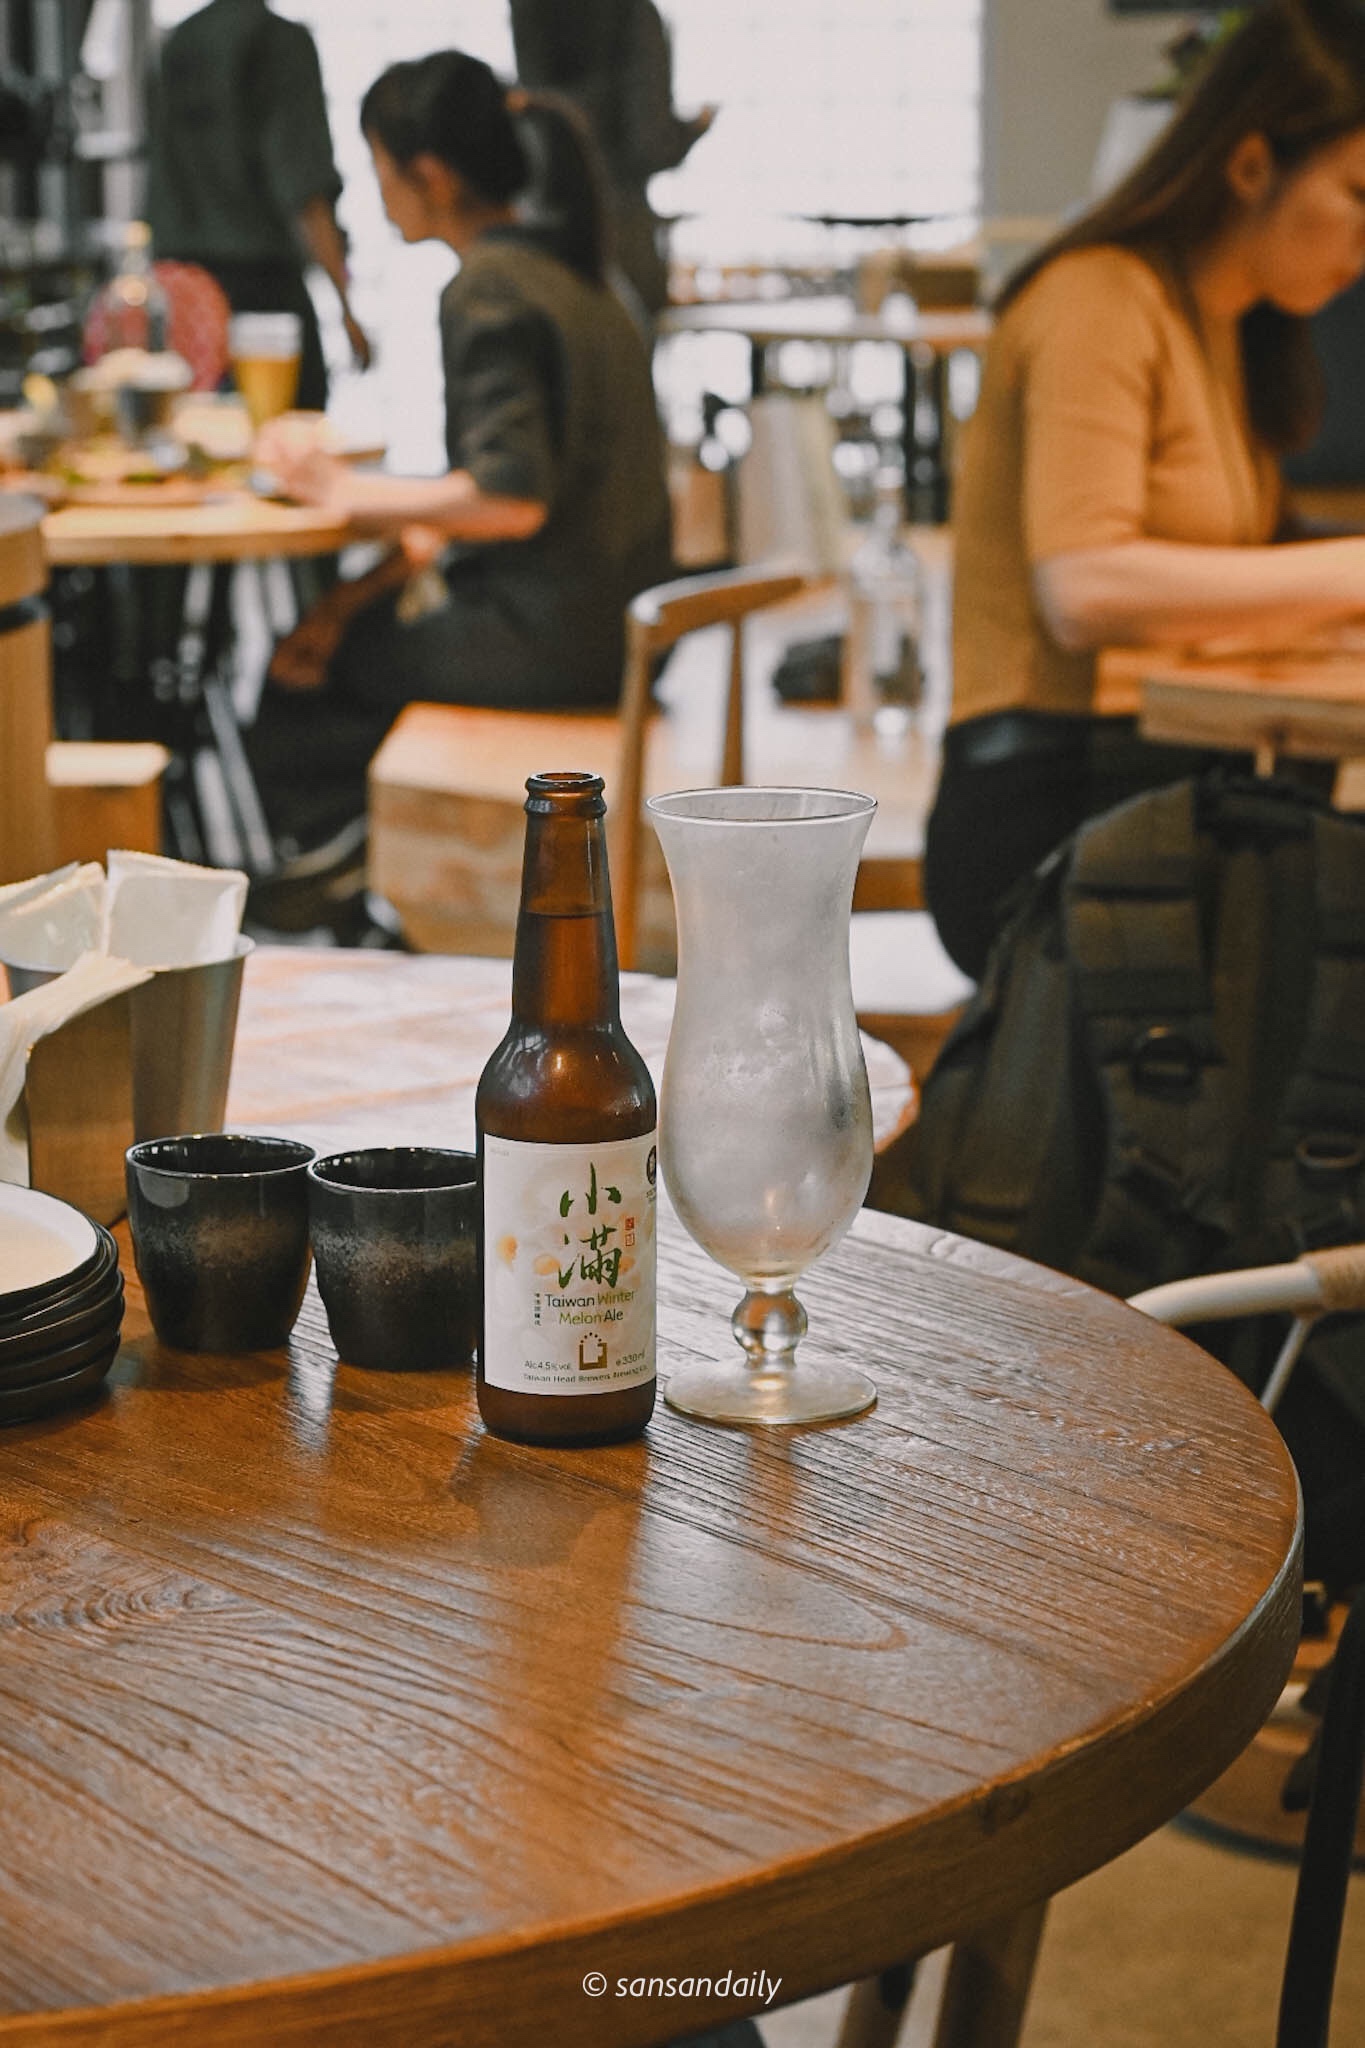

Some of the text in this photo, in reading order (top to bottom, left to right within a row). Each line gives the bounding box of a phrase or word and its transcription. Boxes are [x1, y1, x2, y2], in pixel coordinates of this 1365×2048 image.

[545, 1291, 634, 1308] Taiwan Winter
[559, 1308, 624, 1325] Melon Ale
[553, 1375, 576, 1383] Head
